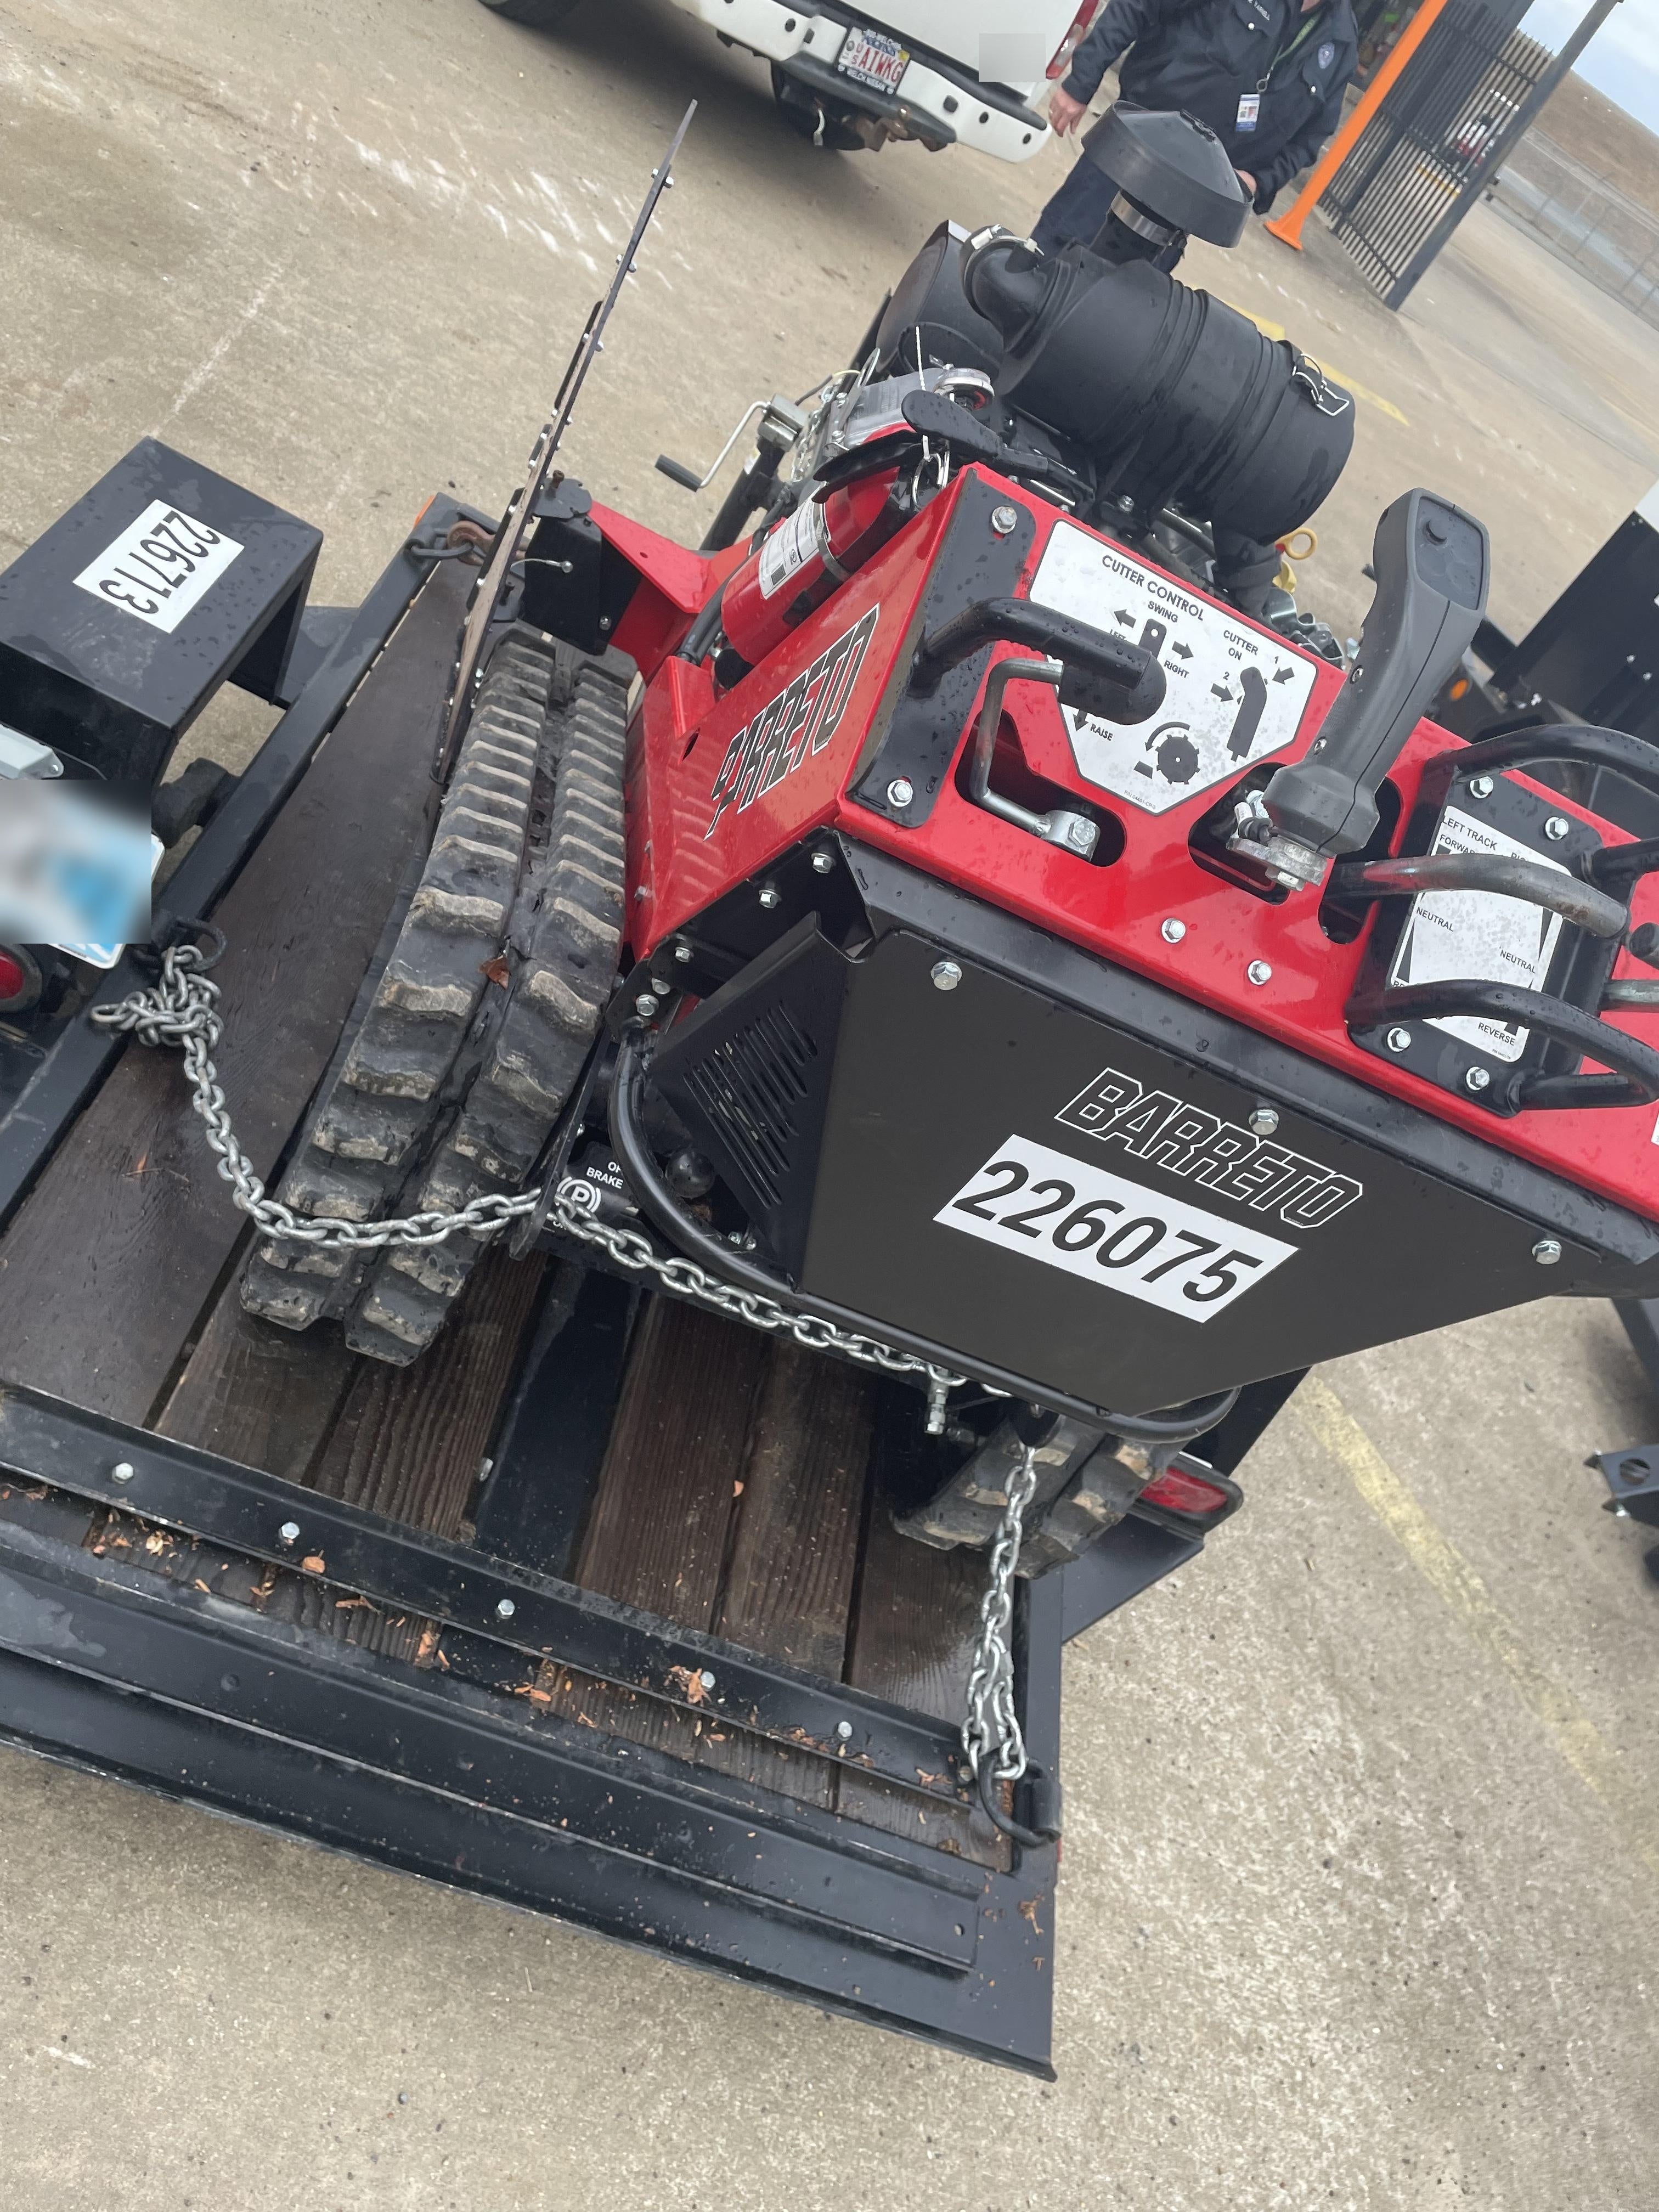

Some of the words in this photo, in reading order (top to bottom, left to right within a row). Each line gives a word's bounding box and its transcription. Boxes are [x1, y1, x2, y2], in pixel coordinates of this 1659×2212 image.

[99, 510, 221, 614] 226713
[1102, 555, 1145, 587] CUTTER
[1147, 580, 1204, 621] CONTROL
[1148, 601, 1178, 623] SWING
[1223, 630, 1259, 656] CUTTER
[1228, 647, 1242, 661] ON
[1164, 659, 1190, 679] RIGHT
[1274, 656, 1279, 664] 1
[1223, 672, 1230, 680] 2
[1090, 724, 1114, 742] RAISE
[1442, 817, 1465, 833] LEFT
[1468, 827, 1498, 850] TRACK
[1416, 906, 1454, 932] NEUTRAL
[1500, 949, 1536, 974] NEUTRAL
[1478, 1022, 1515, 1046] REVERSE
[1054, 1067, 1363, 1229] BARRETO
[586, 1166, 624, 1189] BRAKE
[951, 1160, 1264, 1302] 226075
